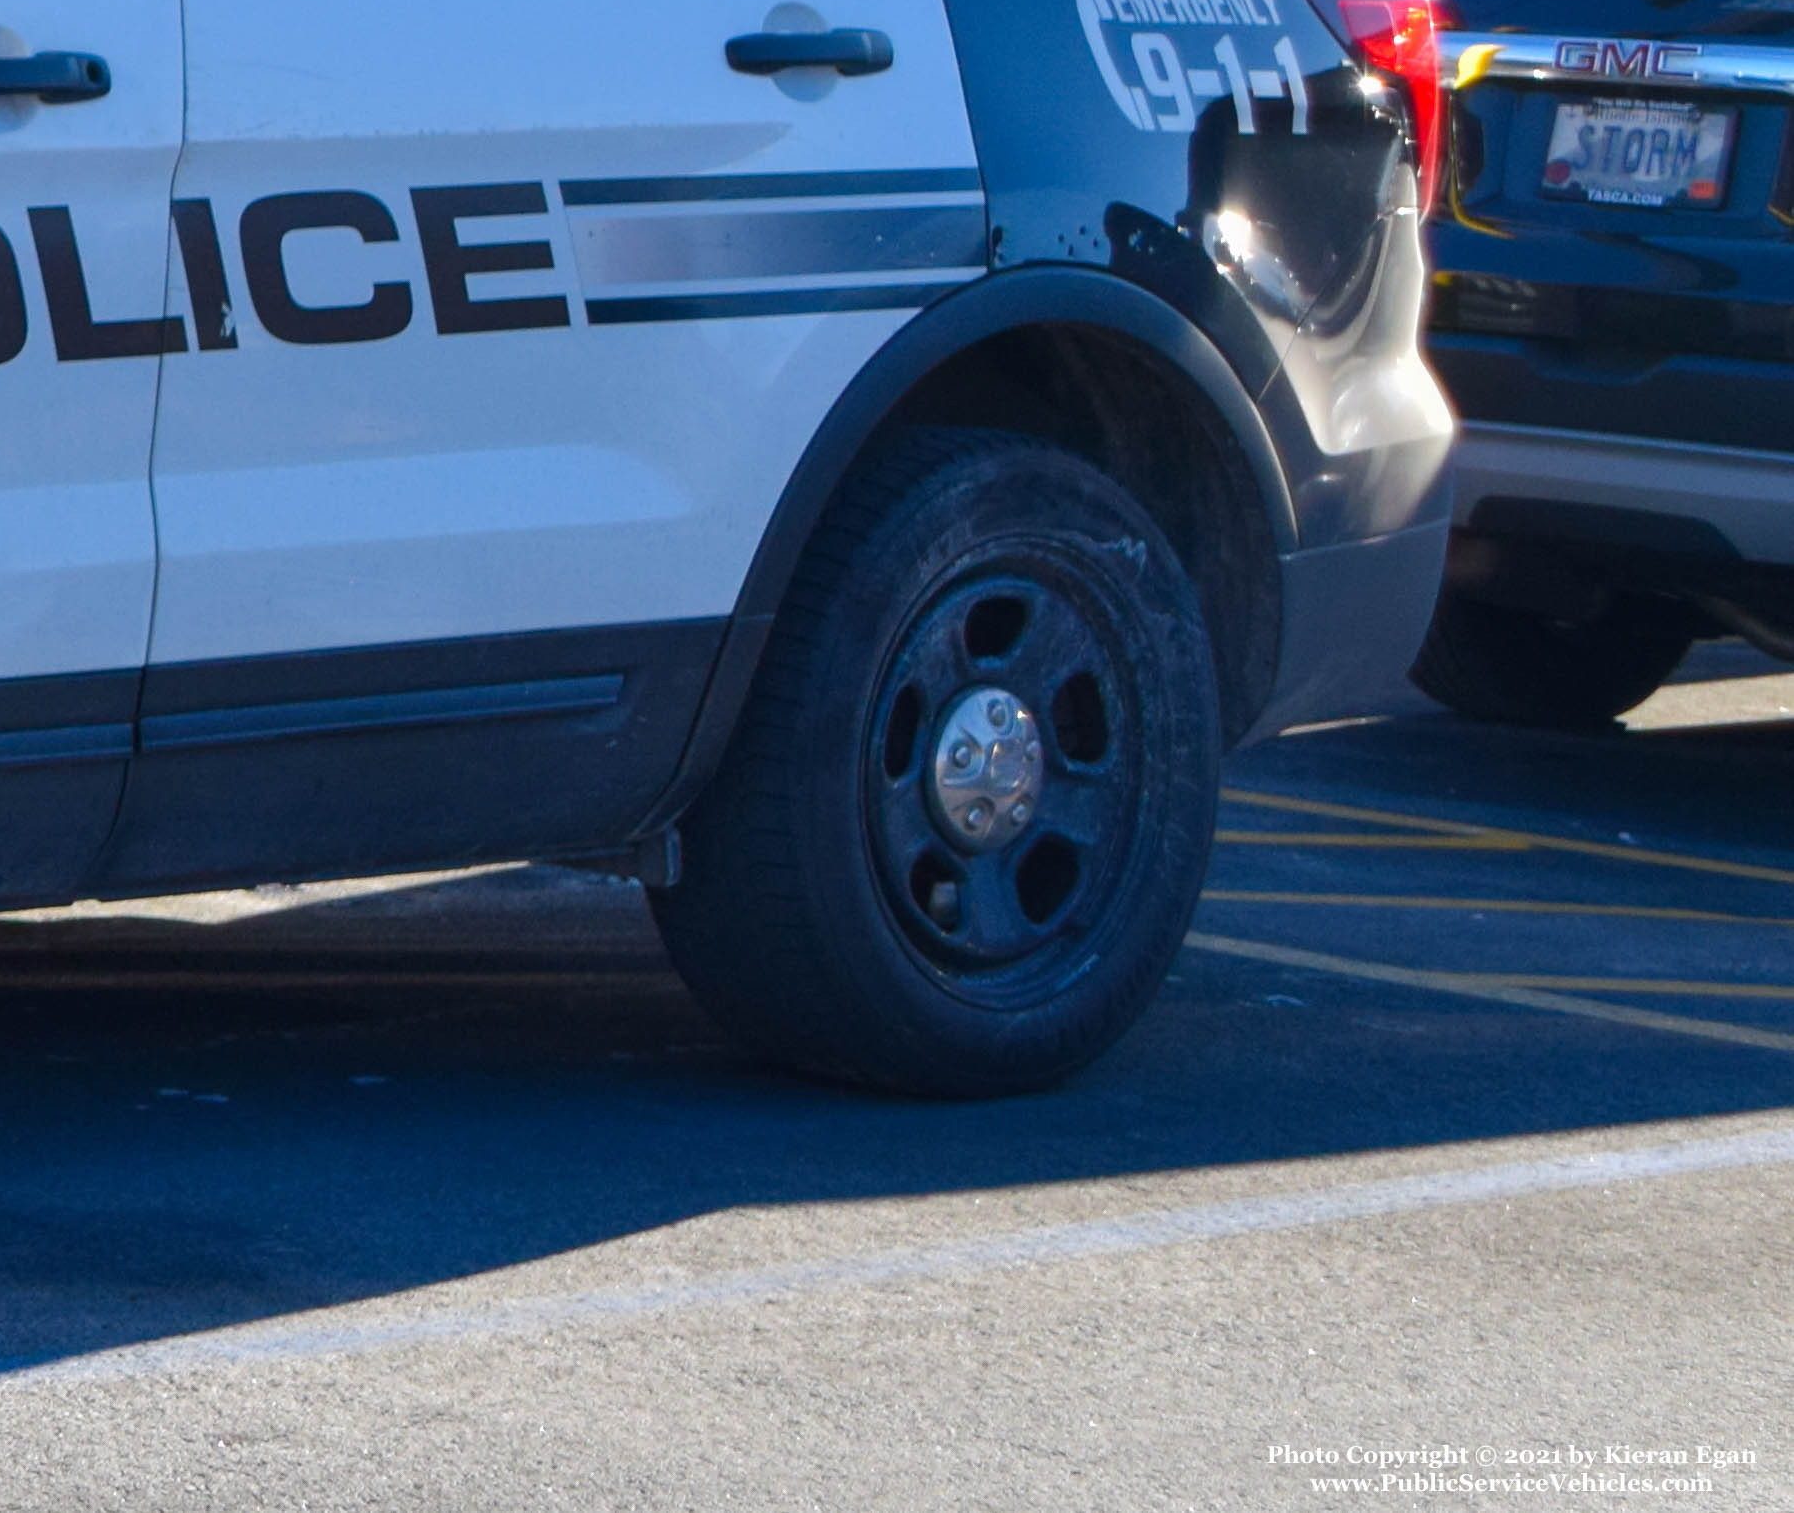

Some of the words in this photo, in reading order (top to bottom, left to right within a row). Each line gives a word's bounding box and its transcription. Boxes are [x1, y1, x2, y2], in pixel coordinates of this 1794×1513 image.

[1131, 33, 1308, 135] 9-1-1
[1553, 39, 1702, 80] GMC
[1571, 124, 1700, 177] STORM
